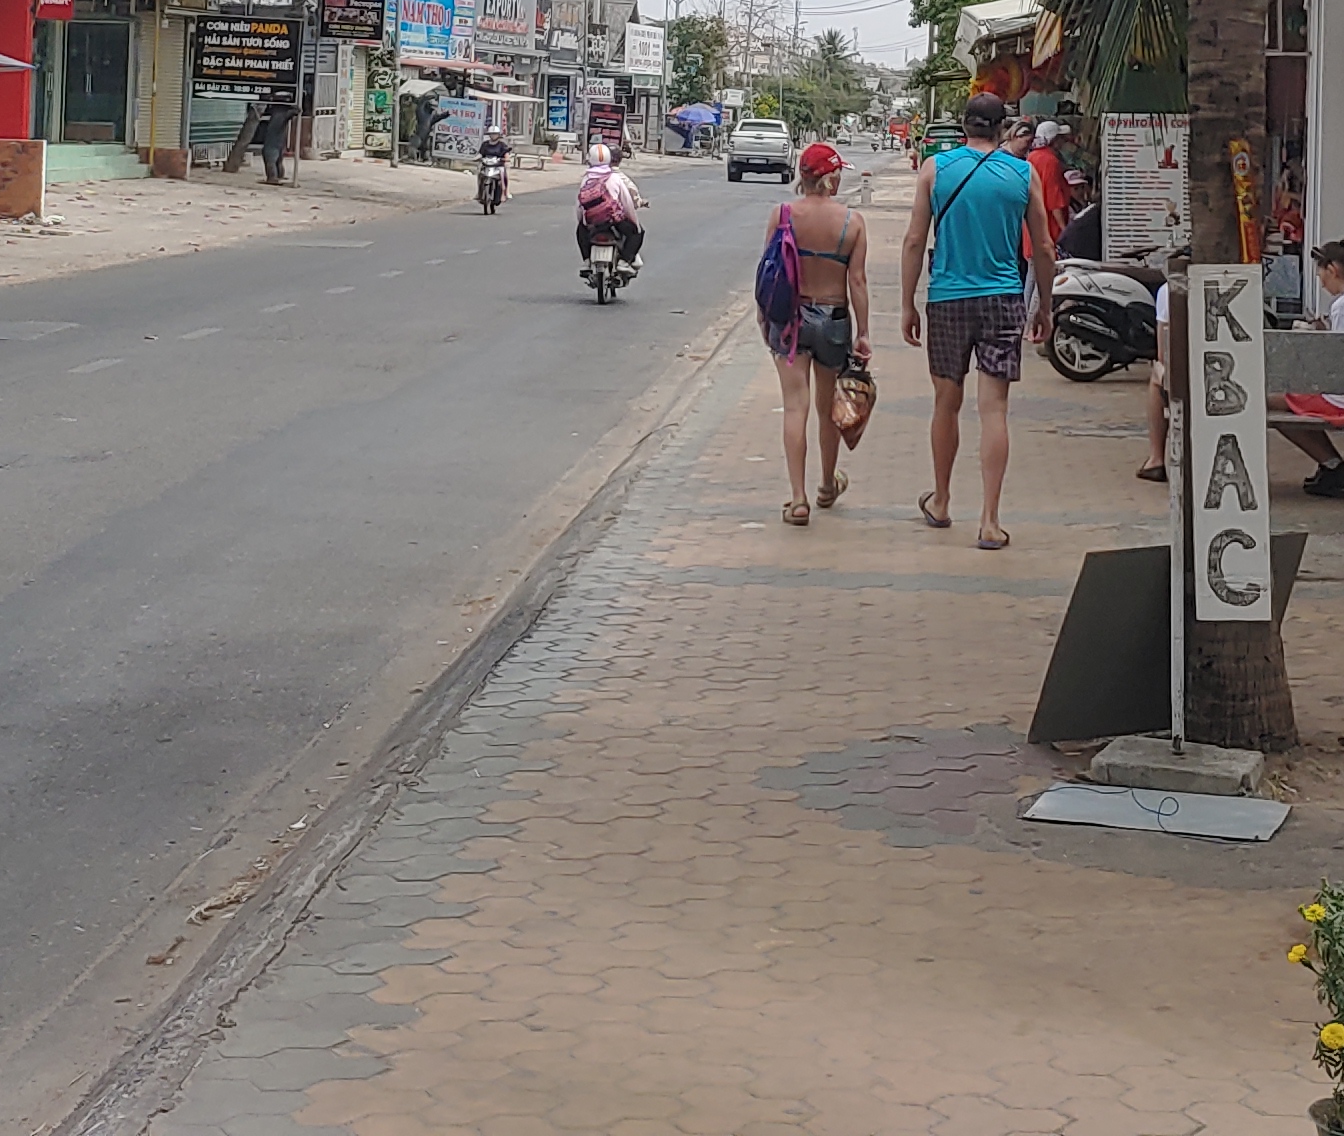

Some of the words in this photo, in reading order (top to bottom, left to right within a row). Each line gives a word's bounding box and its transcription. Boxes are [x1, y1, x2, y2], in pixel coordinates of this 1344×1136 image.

[250, 22, 288, 34] PANDA
[578, 85, 612, 96] MSSAGE
[1109, 119, 1168, 128] ФРУКТОВЫ
[1202, 278, 1261, 606] КВАС
